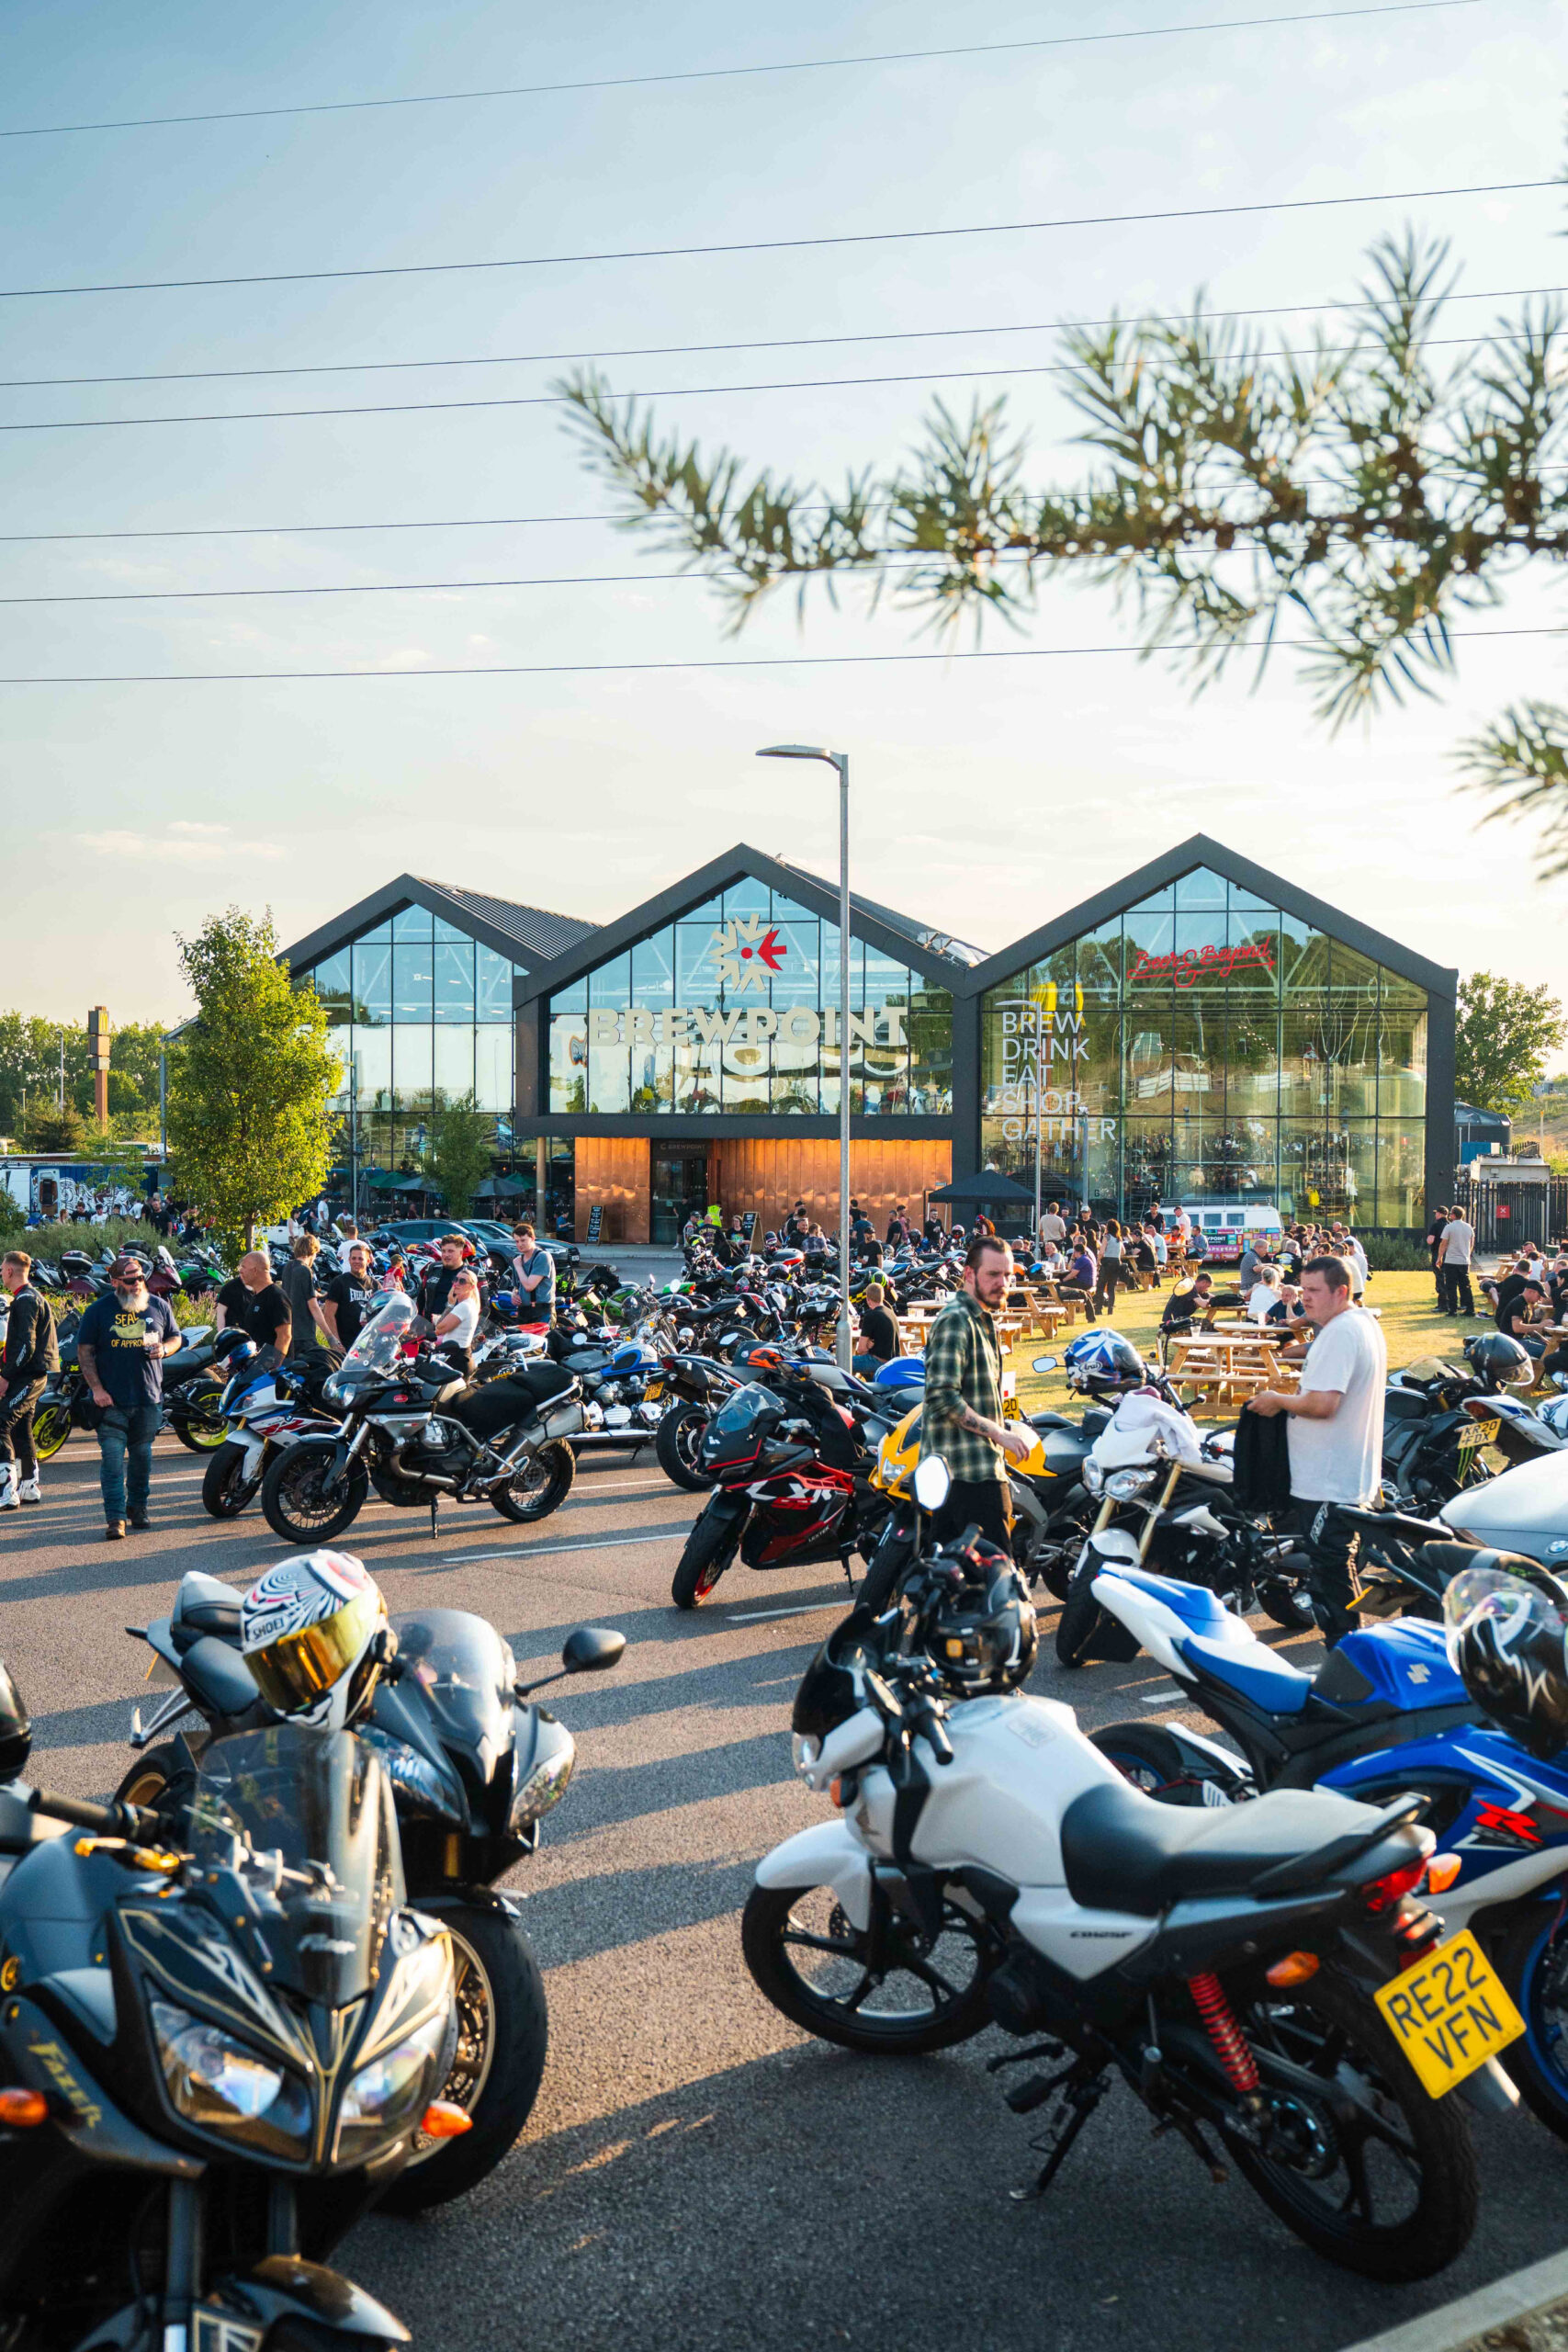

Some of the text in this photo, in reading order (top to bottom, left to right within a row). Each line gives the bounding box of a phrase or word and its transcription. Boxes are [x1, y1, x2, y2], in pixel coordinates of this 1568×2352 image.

[1129, 936, 1271, 988] Beer & Beyond
[588, 1006, 908, 1047] BREWPOINT
[1002, 1012, 1084, 1034] BREW
[1002, 1038, 1090, 1060] DRINK
[1002, 1064, 1055, 1088] EAT
[1001, 1091, 1081, 1114] SHOP
[1001, 1117, 1117, 1140] GATHER
[349, 1287, 373, 1302] EVERLAST
[115, 1311, 140, 1327] SEAL
[111, 1339, 119, 1348] OF
[1464, 1420, 1498, 1436] KR20
[253, 1617, 285, 1640] SHOEI
[1386, 1946, 1487, 2039] RE22
[1423, 1994, 1504, 2070] VFN
